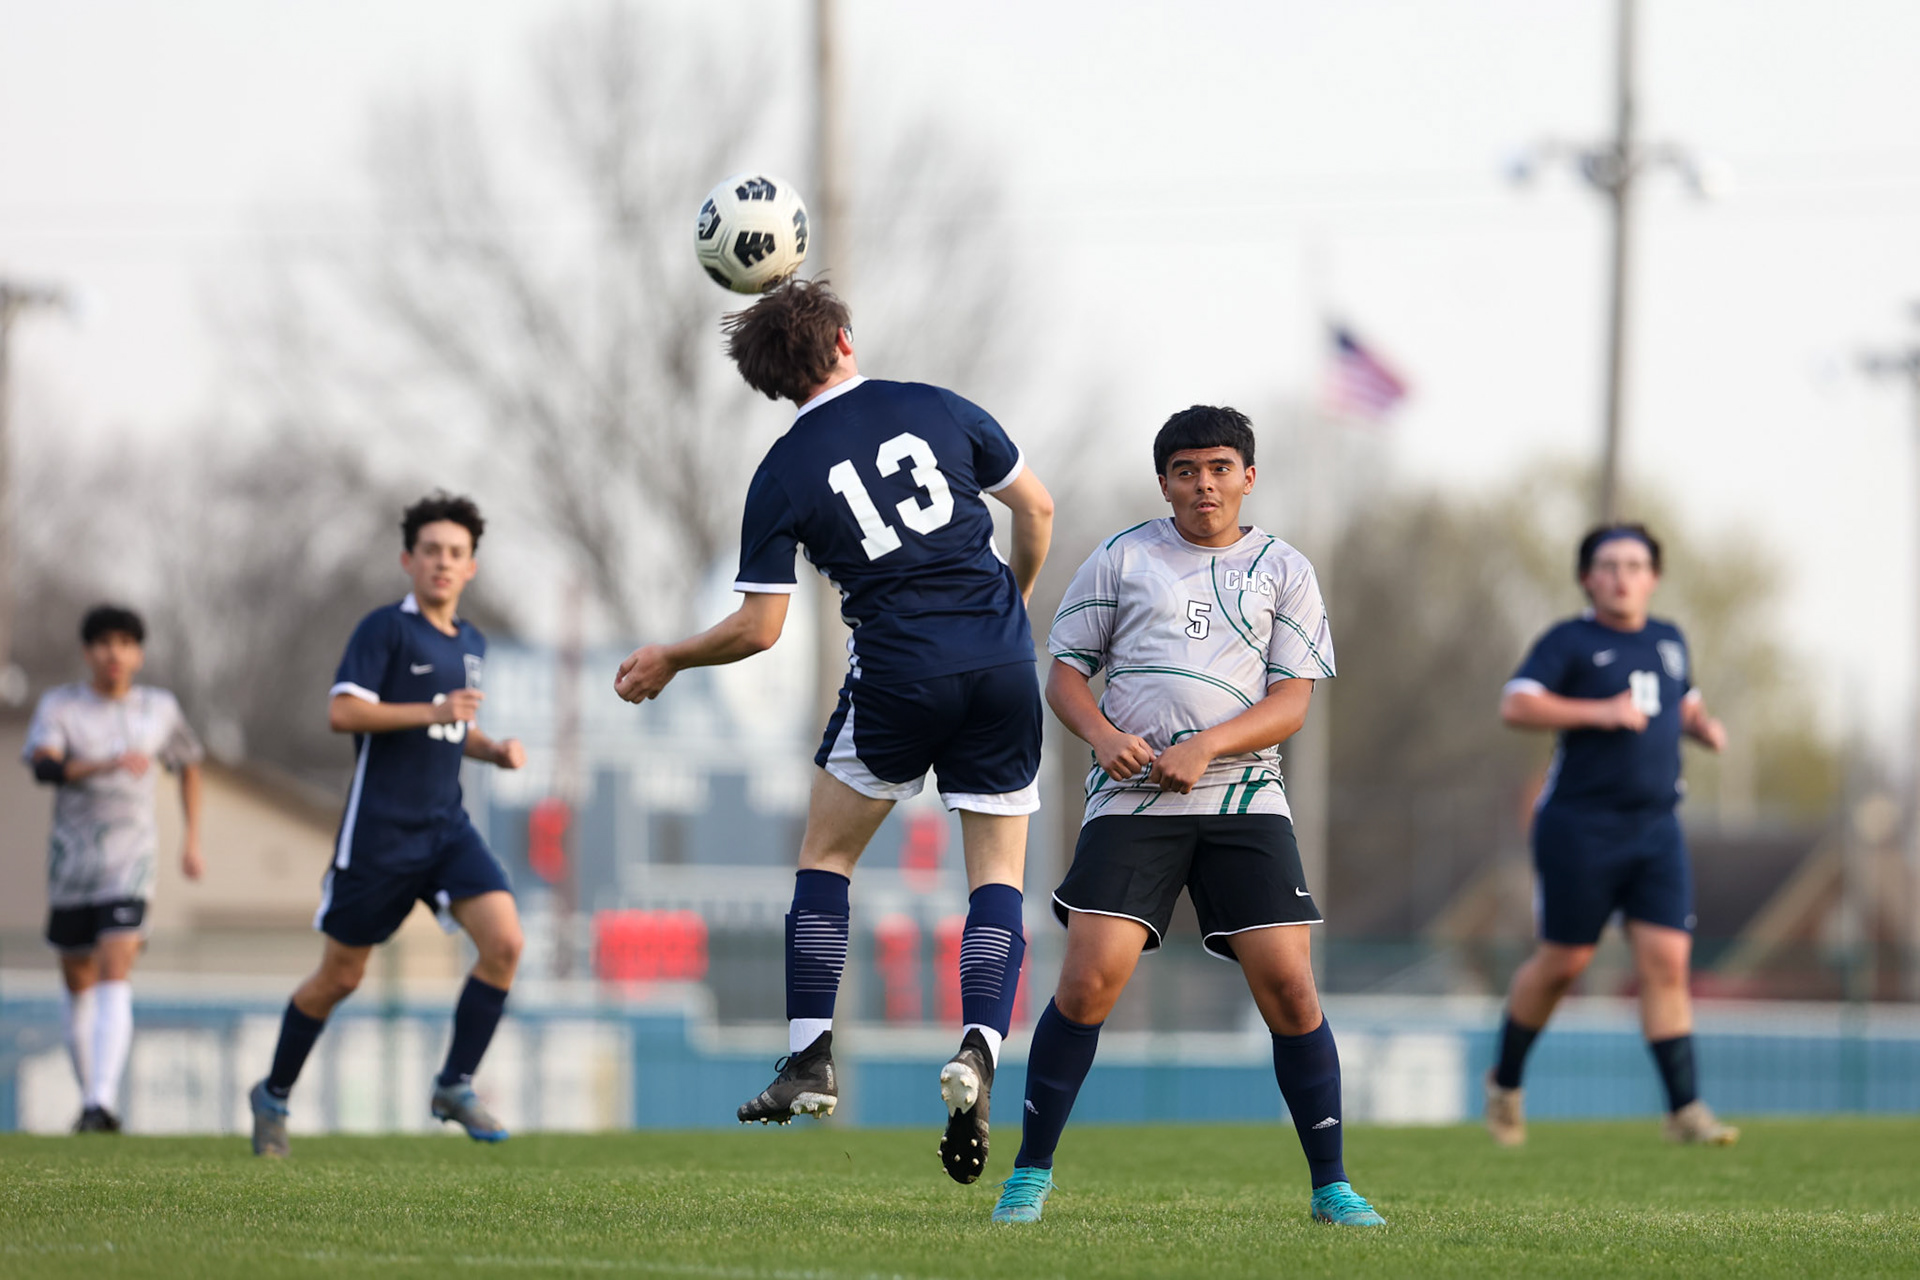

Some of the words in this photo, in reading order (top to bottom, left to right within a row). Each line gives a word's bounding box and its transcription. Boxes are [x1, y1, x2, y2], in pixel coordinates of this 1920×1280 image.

[828, 432, 954, 561] 13
[1224, 569, 1273, 596] CHS
[1185, 600, 1211, 640] 5
